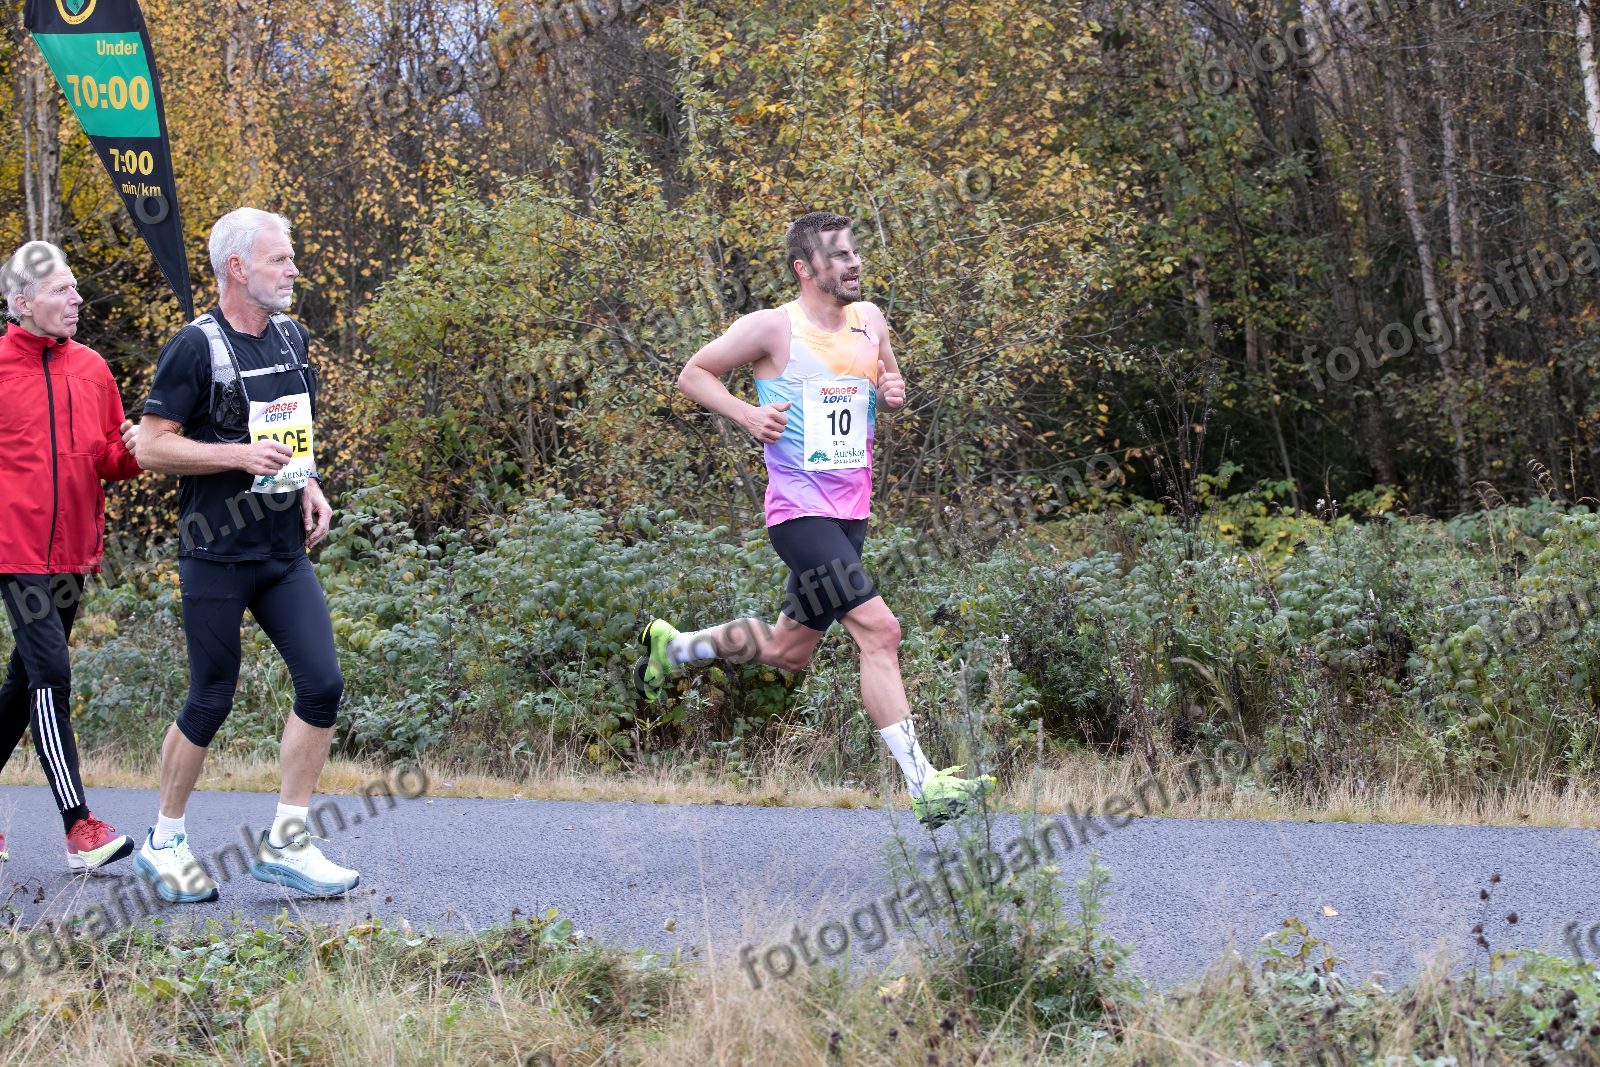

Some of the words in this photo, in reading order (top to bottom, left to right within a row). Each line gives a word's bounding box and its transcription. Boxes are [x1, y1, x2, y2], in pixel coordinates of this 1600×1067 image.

[96, 40, 138, 55] Under
[66, 75, 150, 110] 70:00
[109, 148, 154, 175] 7:00
[121, 181, 162, 198] min/km
[820, 386, 858, 396] NORGES
[823, 394, 853, 404] LØPET
[265, 410, 293, 423] LØPET
[826, 408, 852, 436] 10
[257, 428, 308, 453] CE
